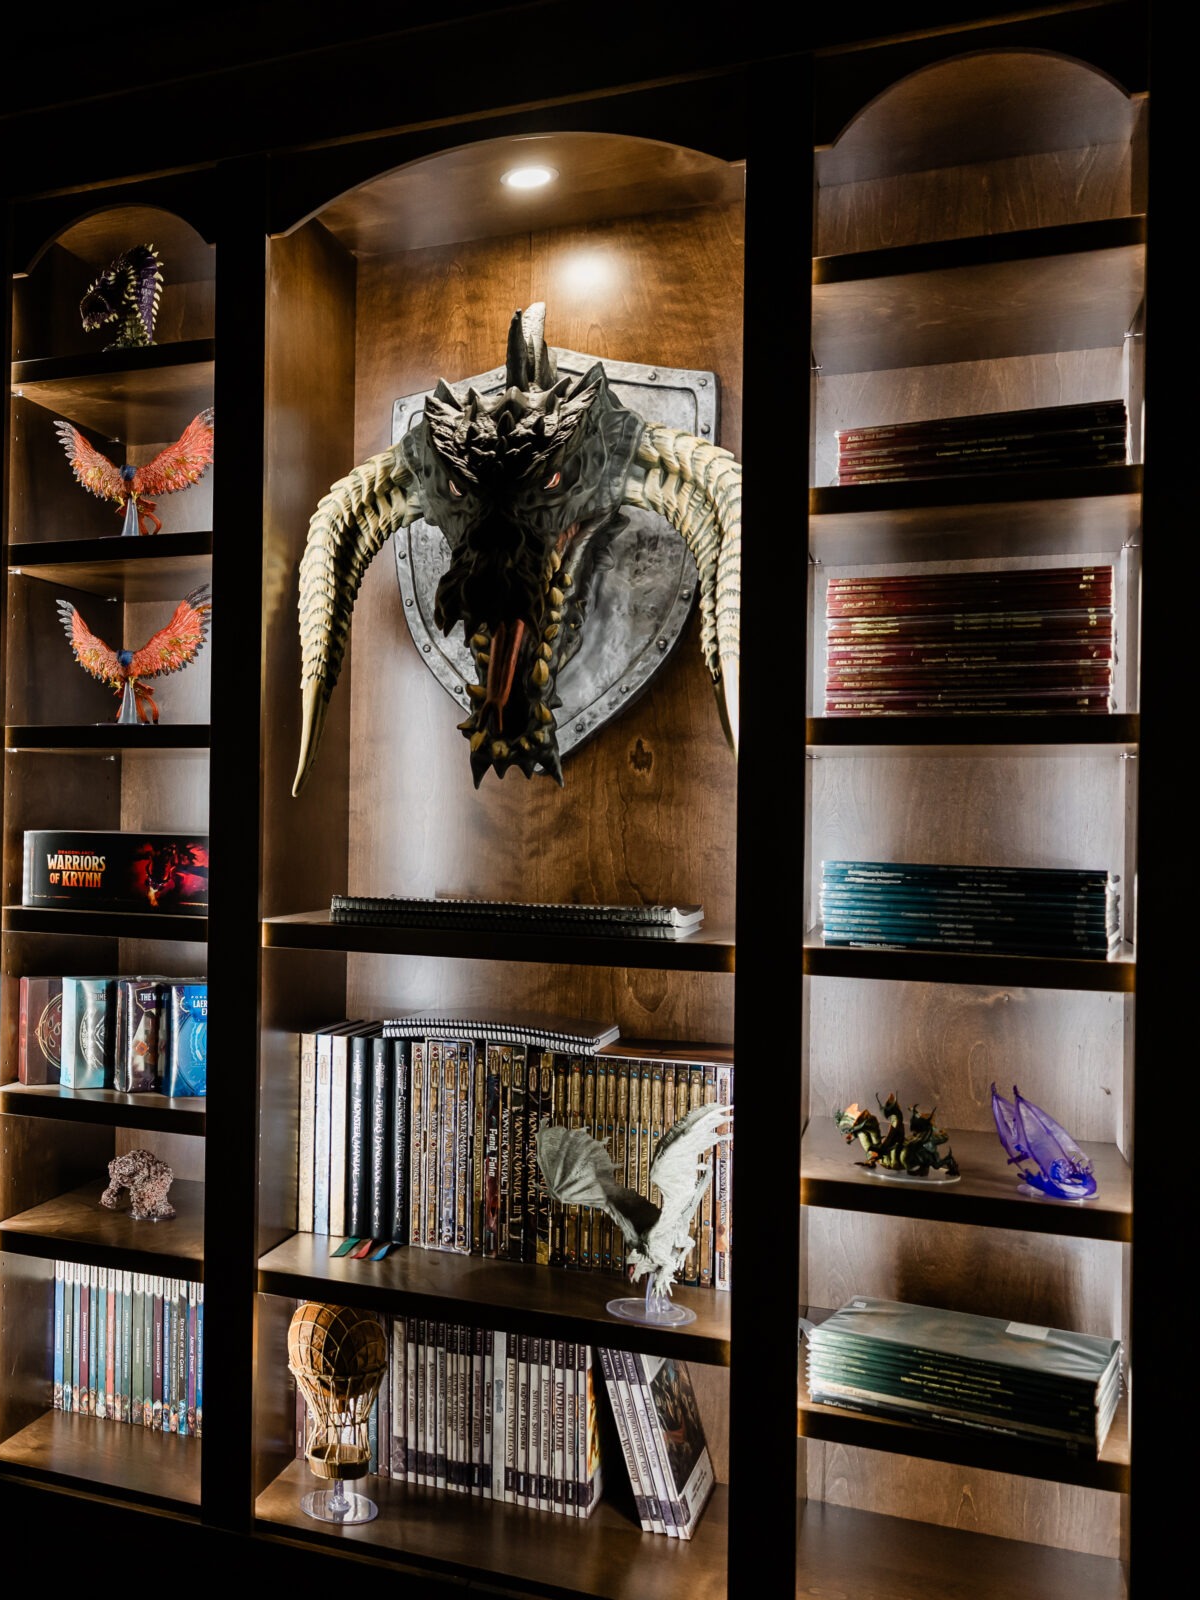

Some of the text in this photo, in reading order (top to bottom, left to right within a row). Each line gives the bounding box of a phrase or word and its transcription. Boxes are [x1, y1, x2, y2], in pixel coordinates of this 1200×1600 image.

[46, 854, 106, 872] WARRIORS
[50, 870, 102, 888] OF KRYNN
[500, 1108, 509, 1146] MONSTER
[512, 1115, 524, 1160] MONSTER
[500, 1149, 509, 1188] MANUAL
[512, 1160, 523, 1202] MANUAL
[507, 1407, 515, 1462] PANTHEONS
[556, 1381, 564, 1451] UNDERDARK
